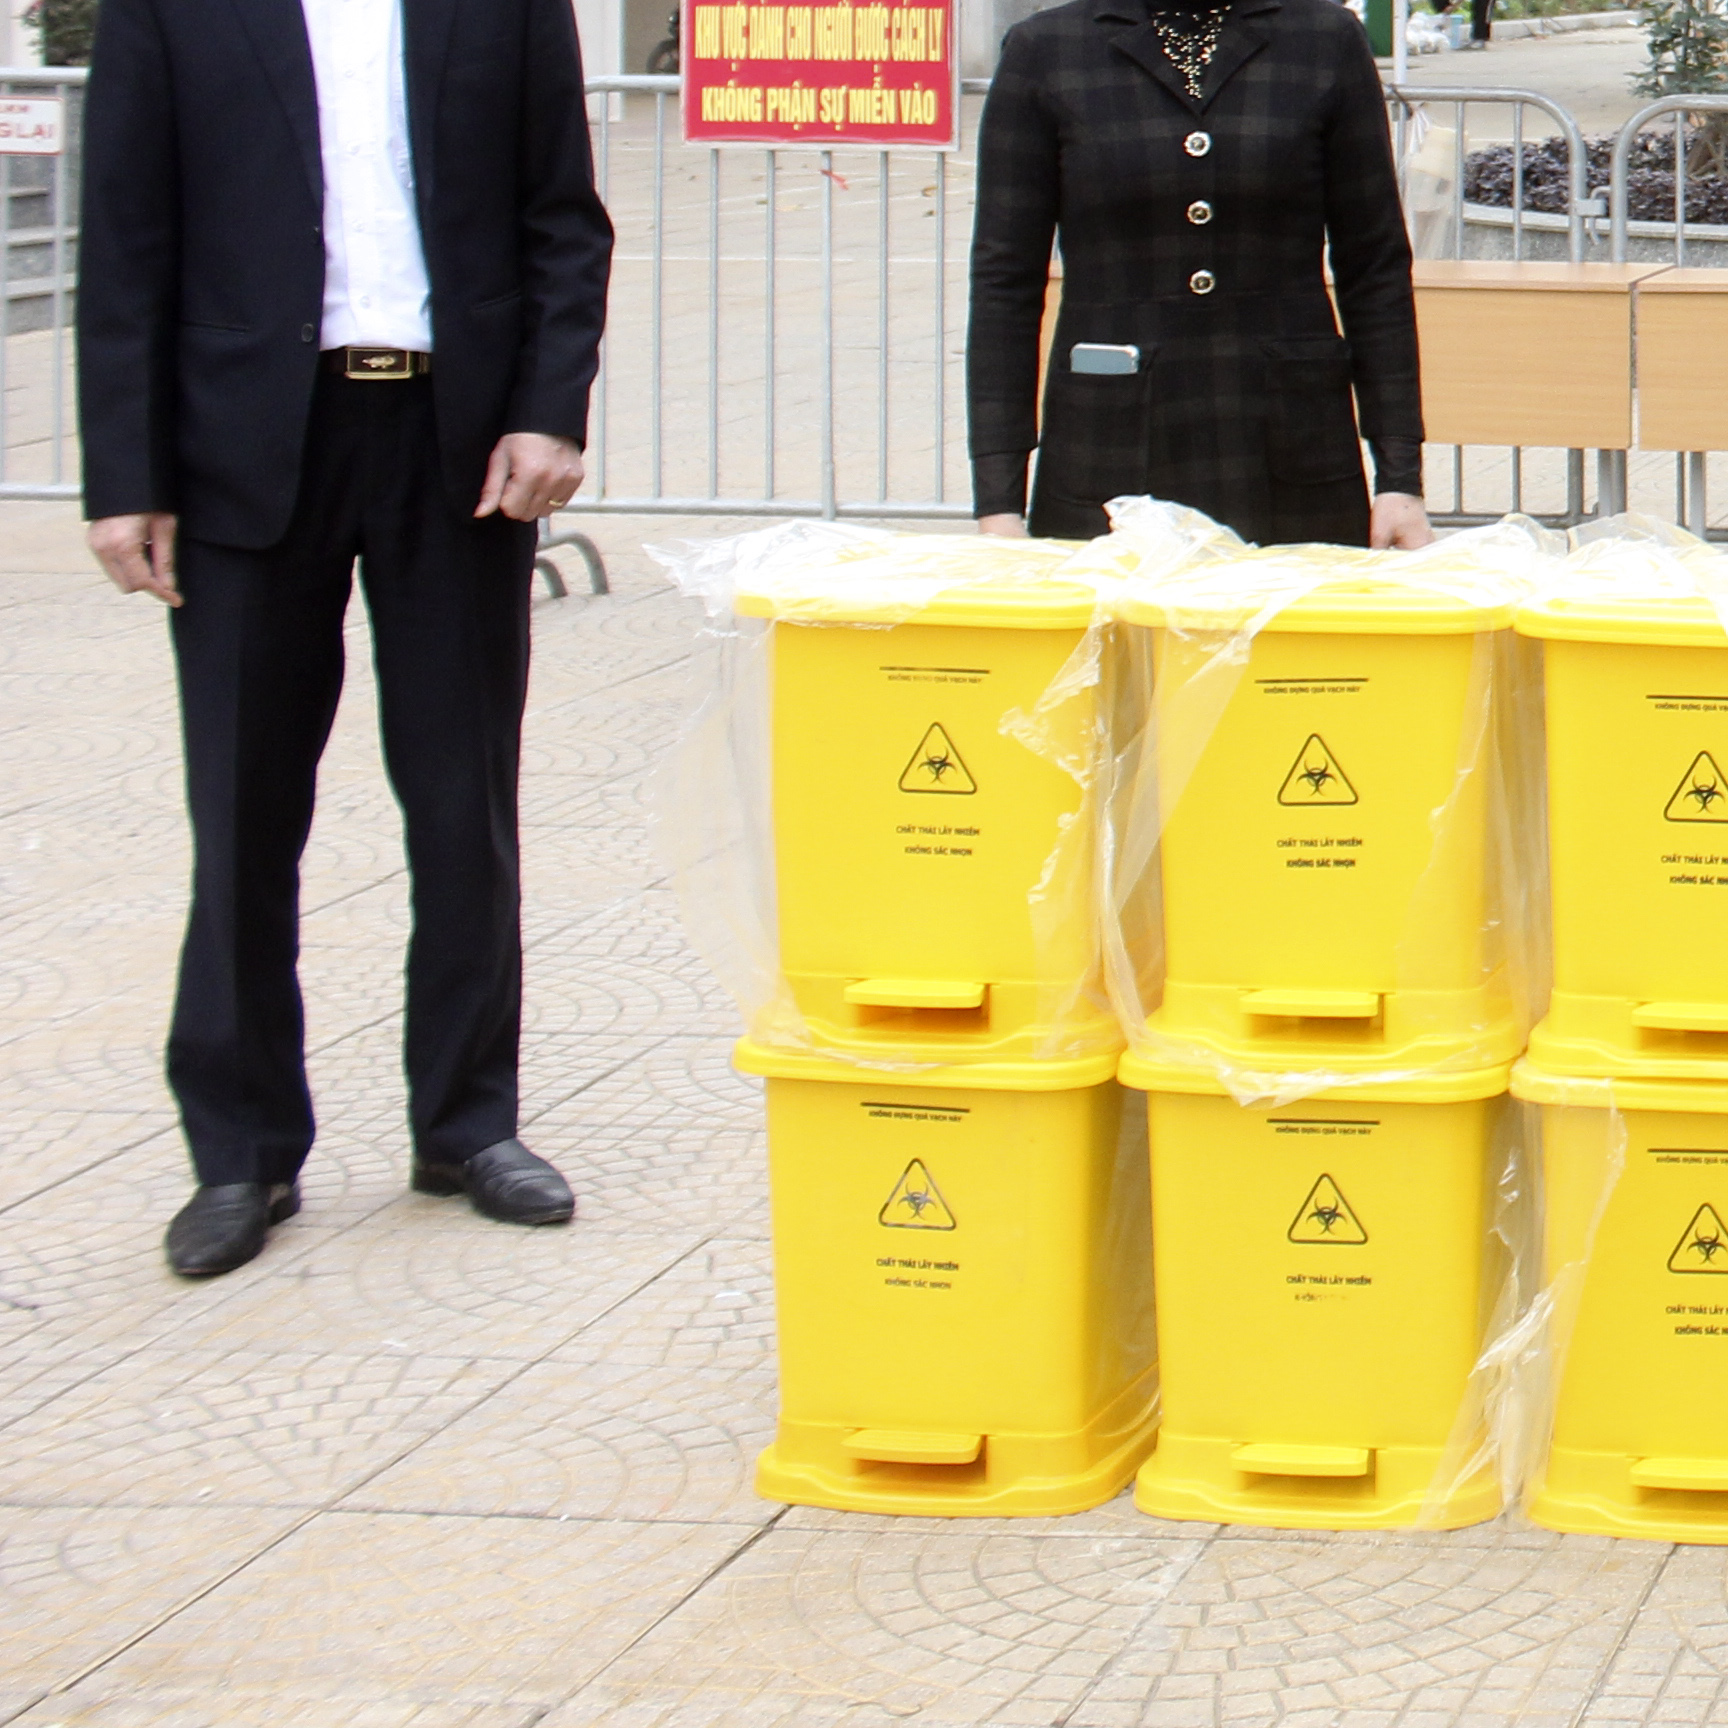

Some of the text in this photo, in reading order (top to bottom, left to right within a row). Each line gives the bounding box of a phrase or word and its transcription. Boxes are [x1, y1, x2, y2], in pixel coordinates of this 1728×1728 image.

[702, 77, 937, 130] KHÔNG PHẬN SỰ MIỄN VÀO
